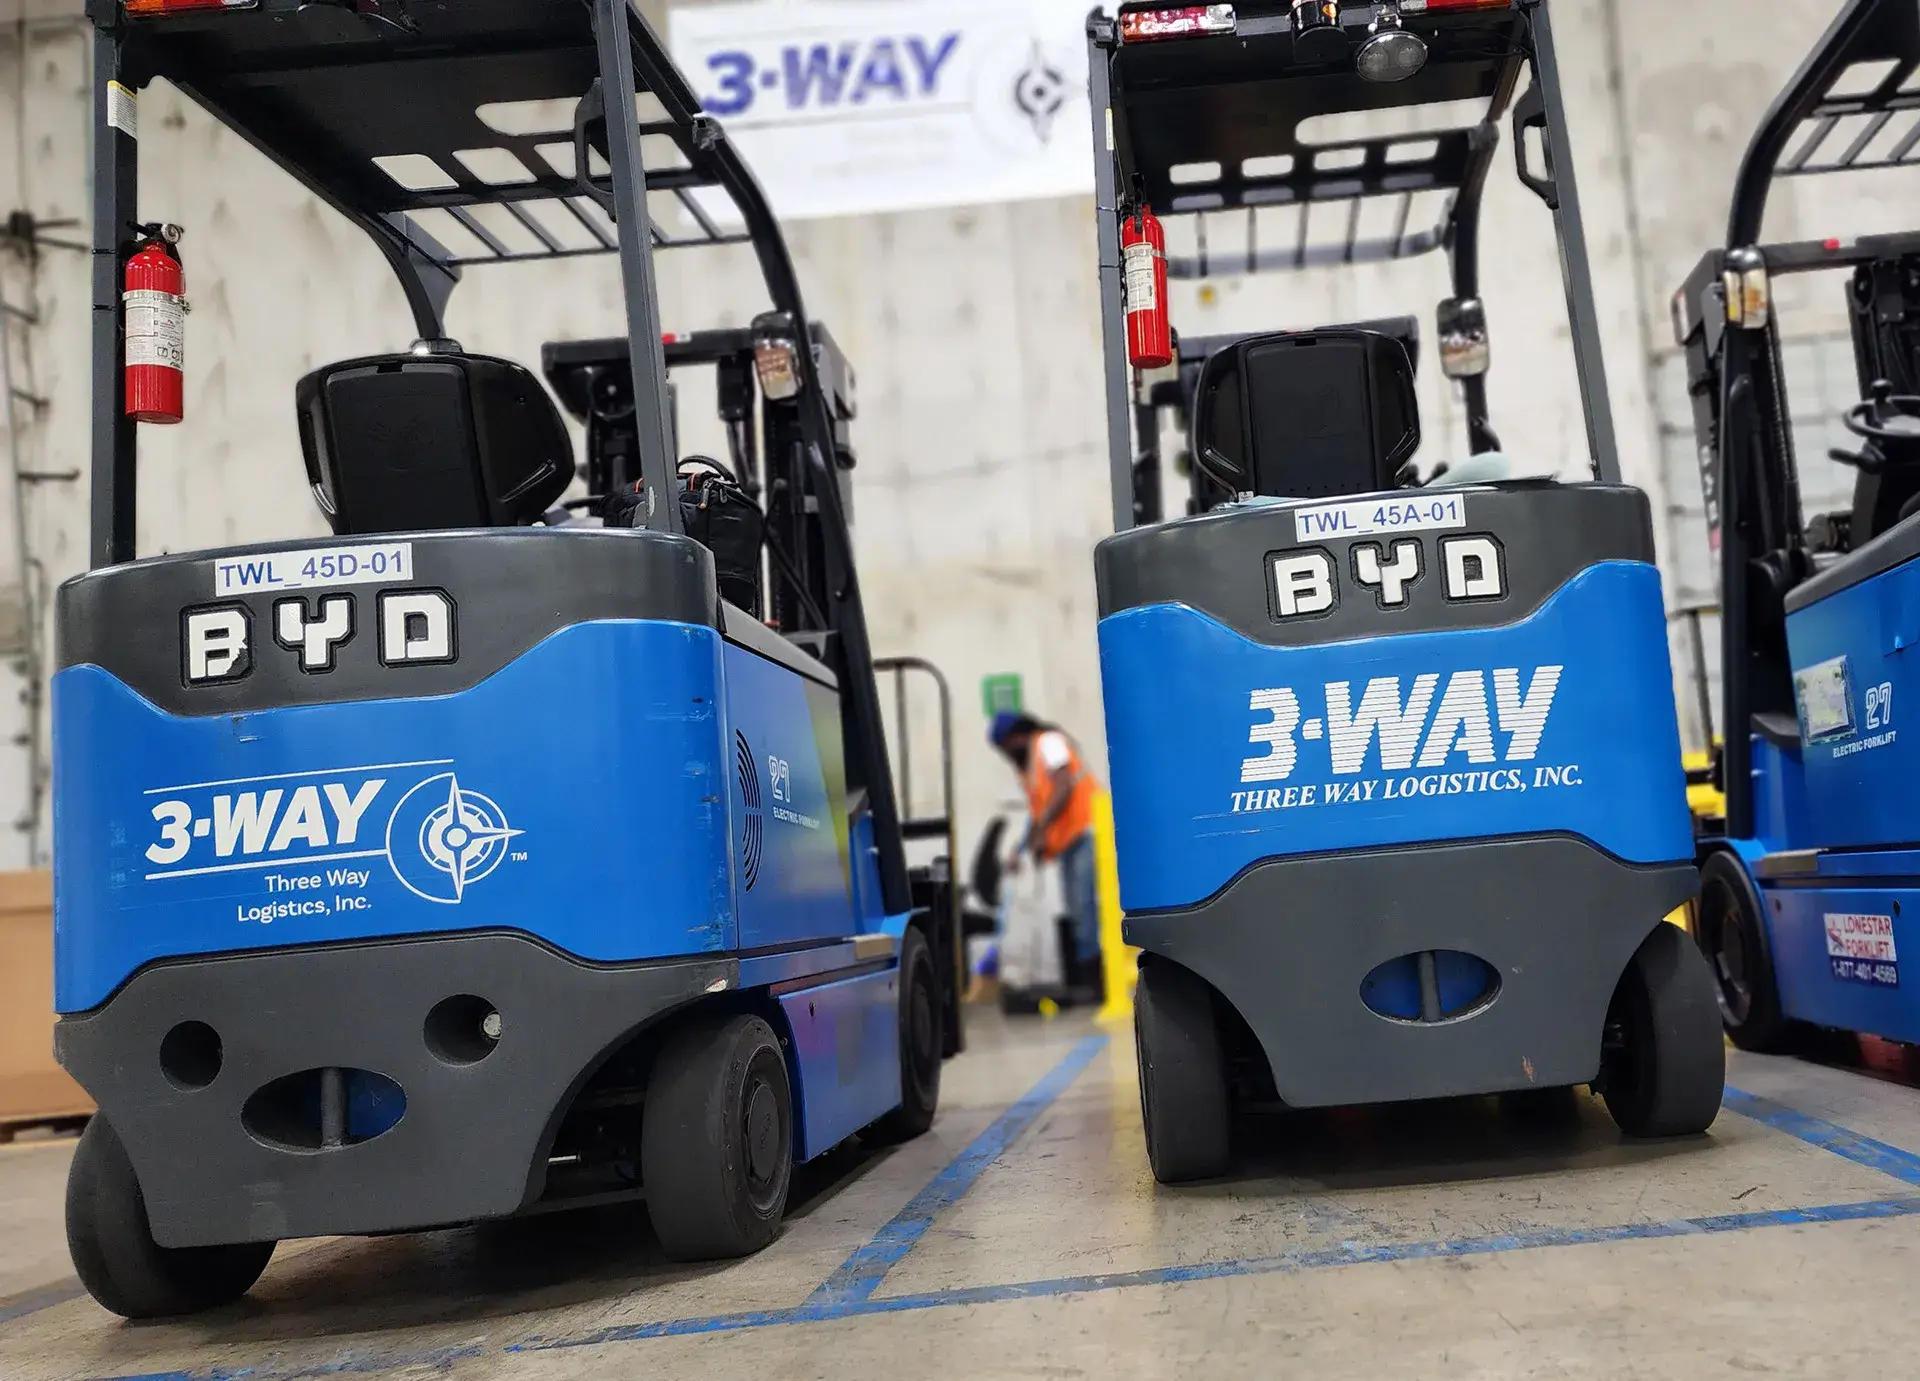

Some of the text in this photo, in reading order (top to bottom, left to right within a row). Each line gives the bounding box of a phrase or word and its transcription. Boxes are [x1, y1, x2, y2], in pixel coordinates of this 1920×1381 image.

[1298, 500, 1457, 534] TWL_45A-01
[219, 550, 402, 588] TWL_45D-01
[1274, 539, 1501, 616] BYD
[188, 593, 449, 679] BYD
[1865, 681, 1892, 730] 27
[1832, 730, 1897, 758] ELECTRIC FORKLIFT
[768, 754, 791, 803] 27
[1230, 765, 1583, 813] THREE WAY LOGISTICS, INC.
[145, 778, 387, 865] 3-WAY
[264, 868, 371, 893] Three Way
[237, 894, 372, 924] Logistics, Inc.
[1843, 916, 1892, 936] LONESTAR
[1845, 939, 1890, 960] FORKLIFT
